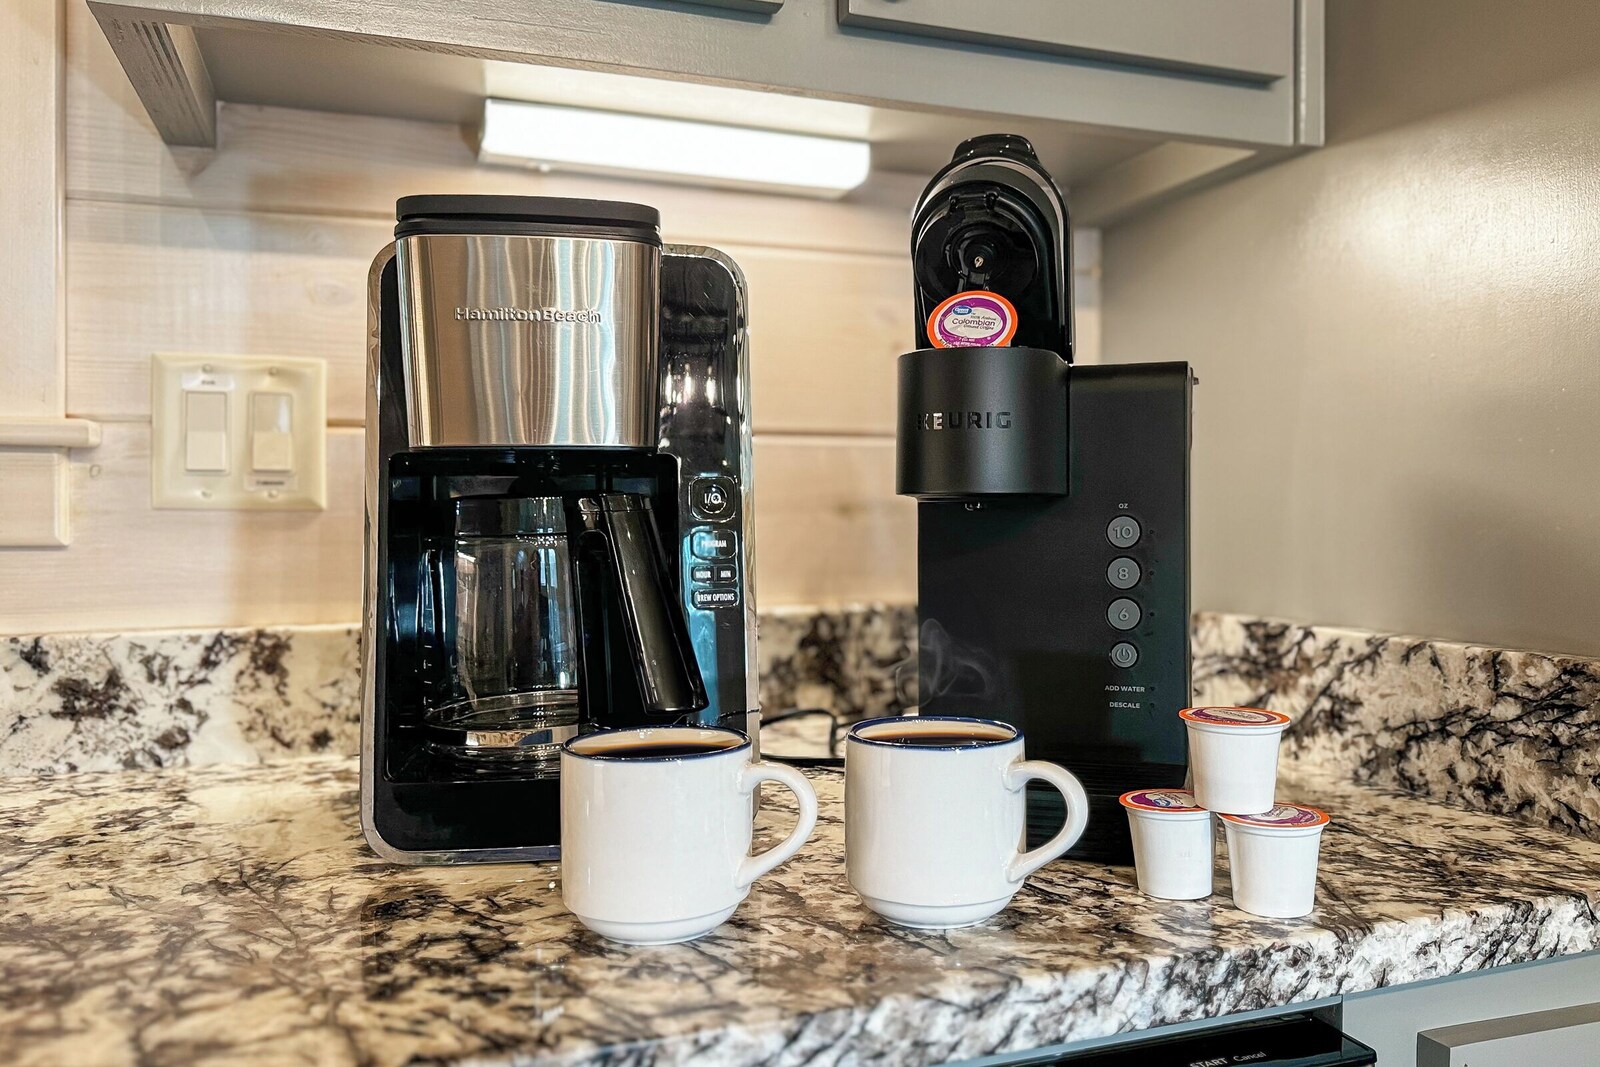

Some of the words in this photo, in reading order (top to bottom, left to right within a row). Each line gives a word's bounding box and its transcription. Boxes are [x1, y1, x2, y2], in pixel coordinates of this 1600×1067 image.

[455, 307, 541, 322] Hamilton
[542, 307, 601, 324] Beach
[952, 317, 996, 327] Colombian
[917, 411, 1012, 431] KEURIG
[1112, 525, 1133, 540] 10
[1117, 567, 1129, 580] 8
[697, 593, 712, 603] BREW
[712, 593, 735, 602] OPTIONS
[1118, 607, 1130, 621] 6
[1109, 701, 1141, 709] DESCALE
[1233, 1051, 1267, 1062] Cancel
